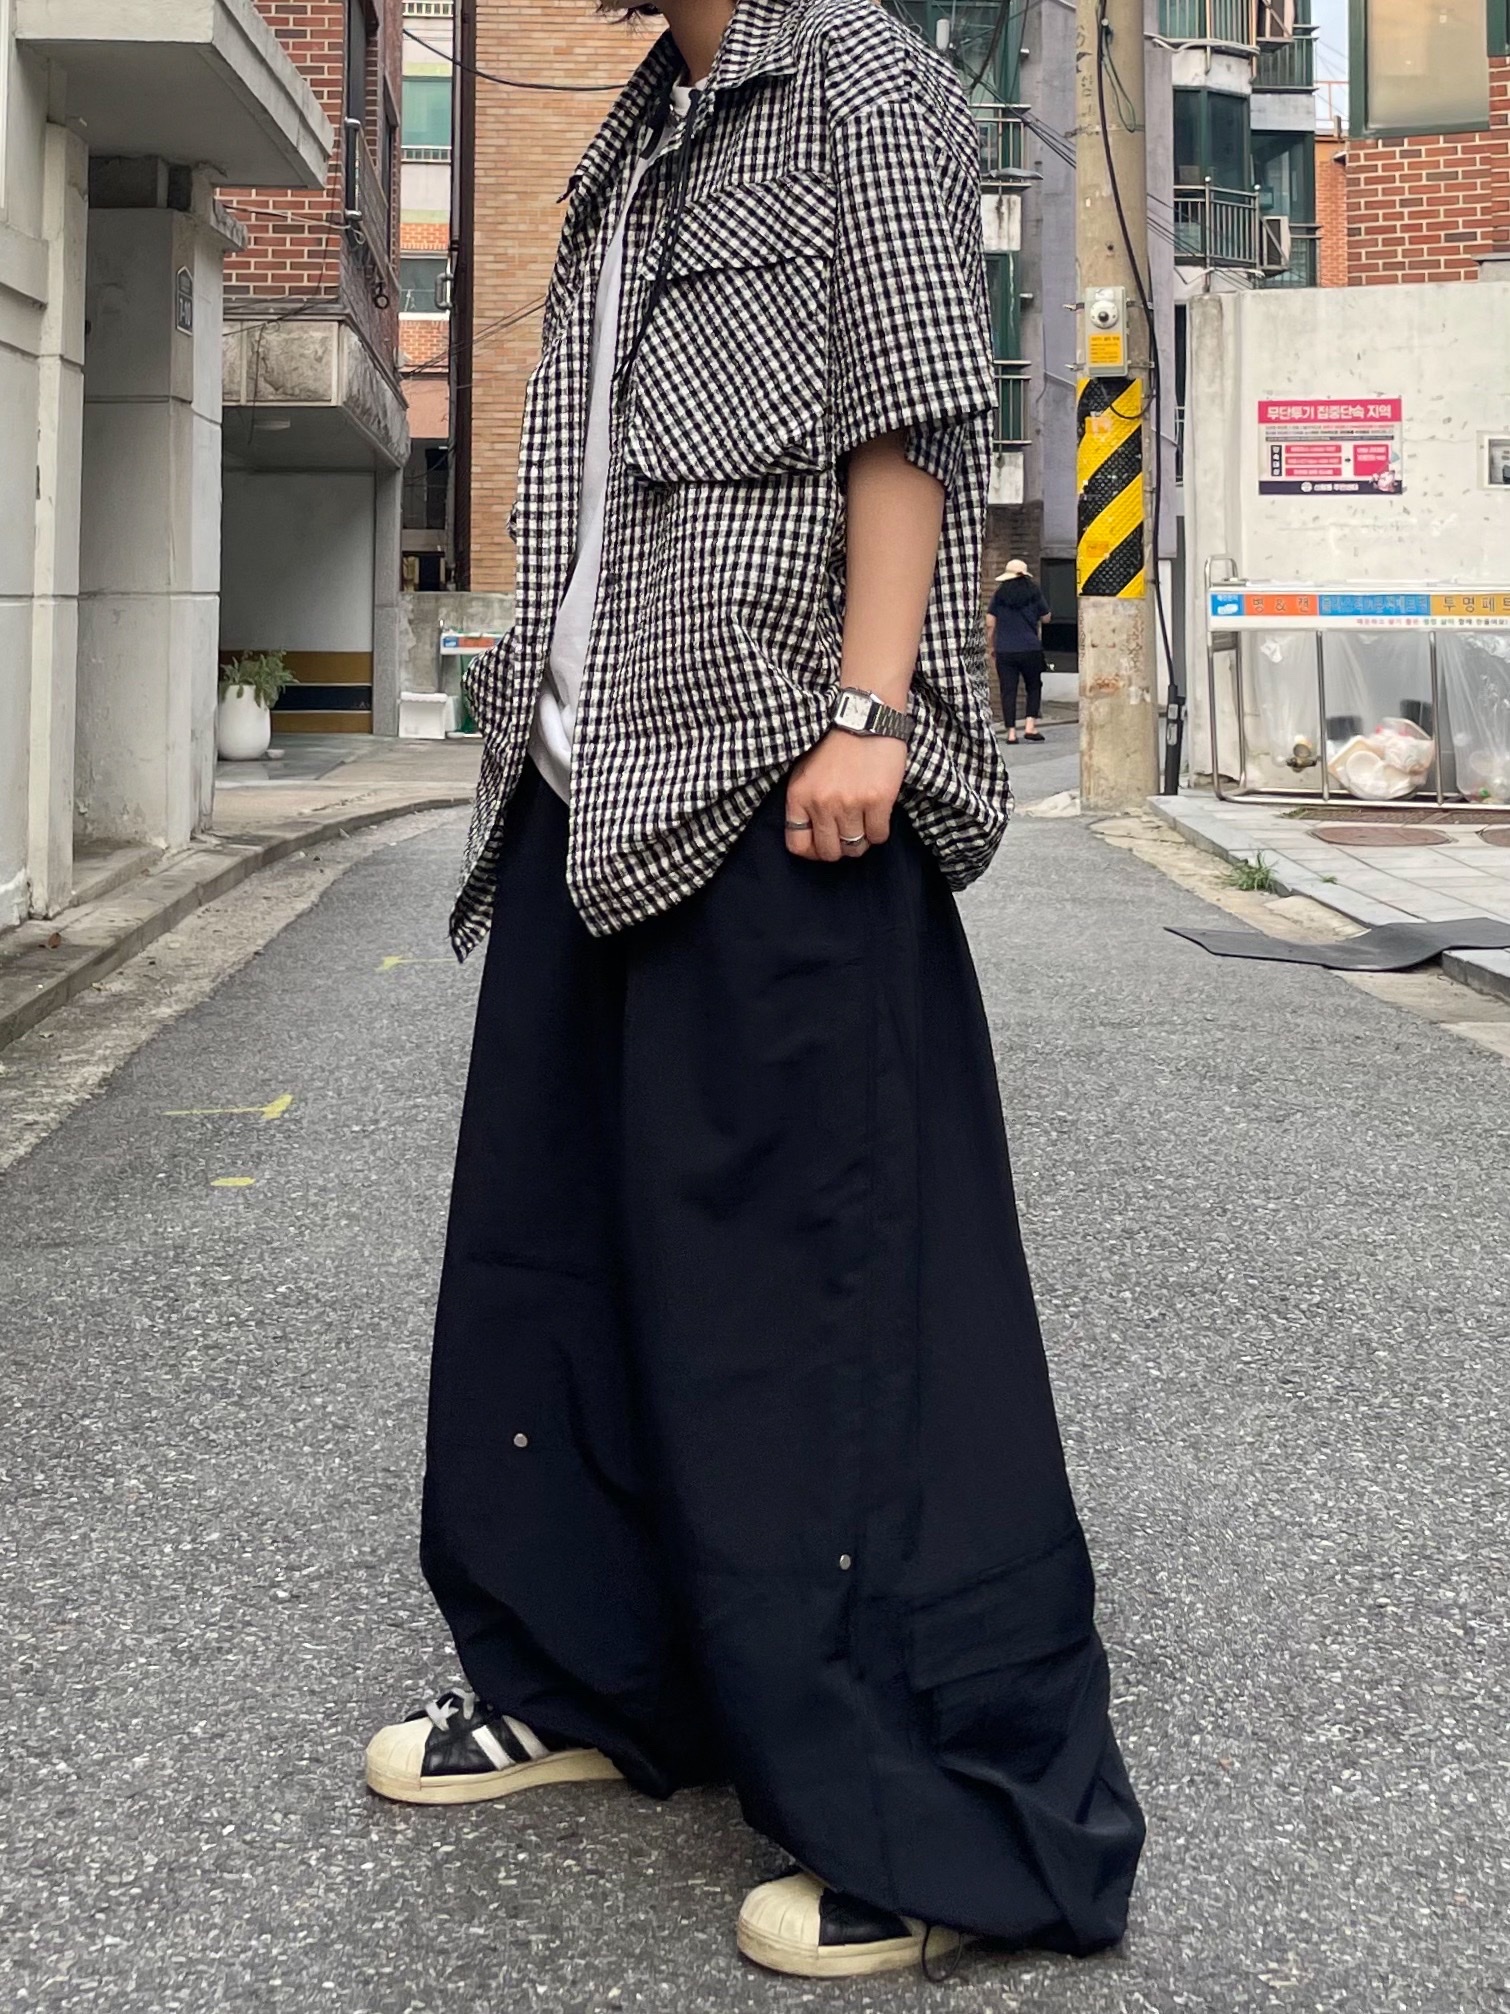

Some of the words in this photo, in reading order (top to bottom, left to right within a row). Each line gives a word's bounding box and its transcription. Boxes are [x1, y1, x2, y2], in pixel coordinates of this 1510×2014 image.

[1267, 405, 1315, 420] 무단투기
[1317, 405, 1365, 420] 집중단속
[1367, 404, 1392, 419] 지역
